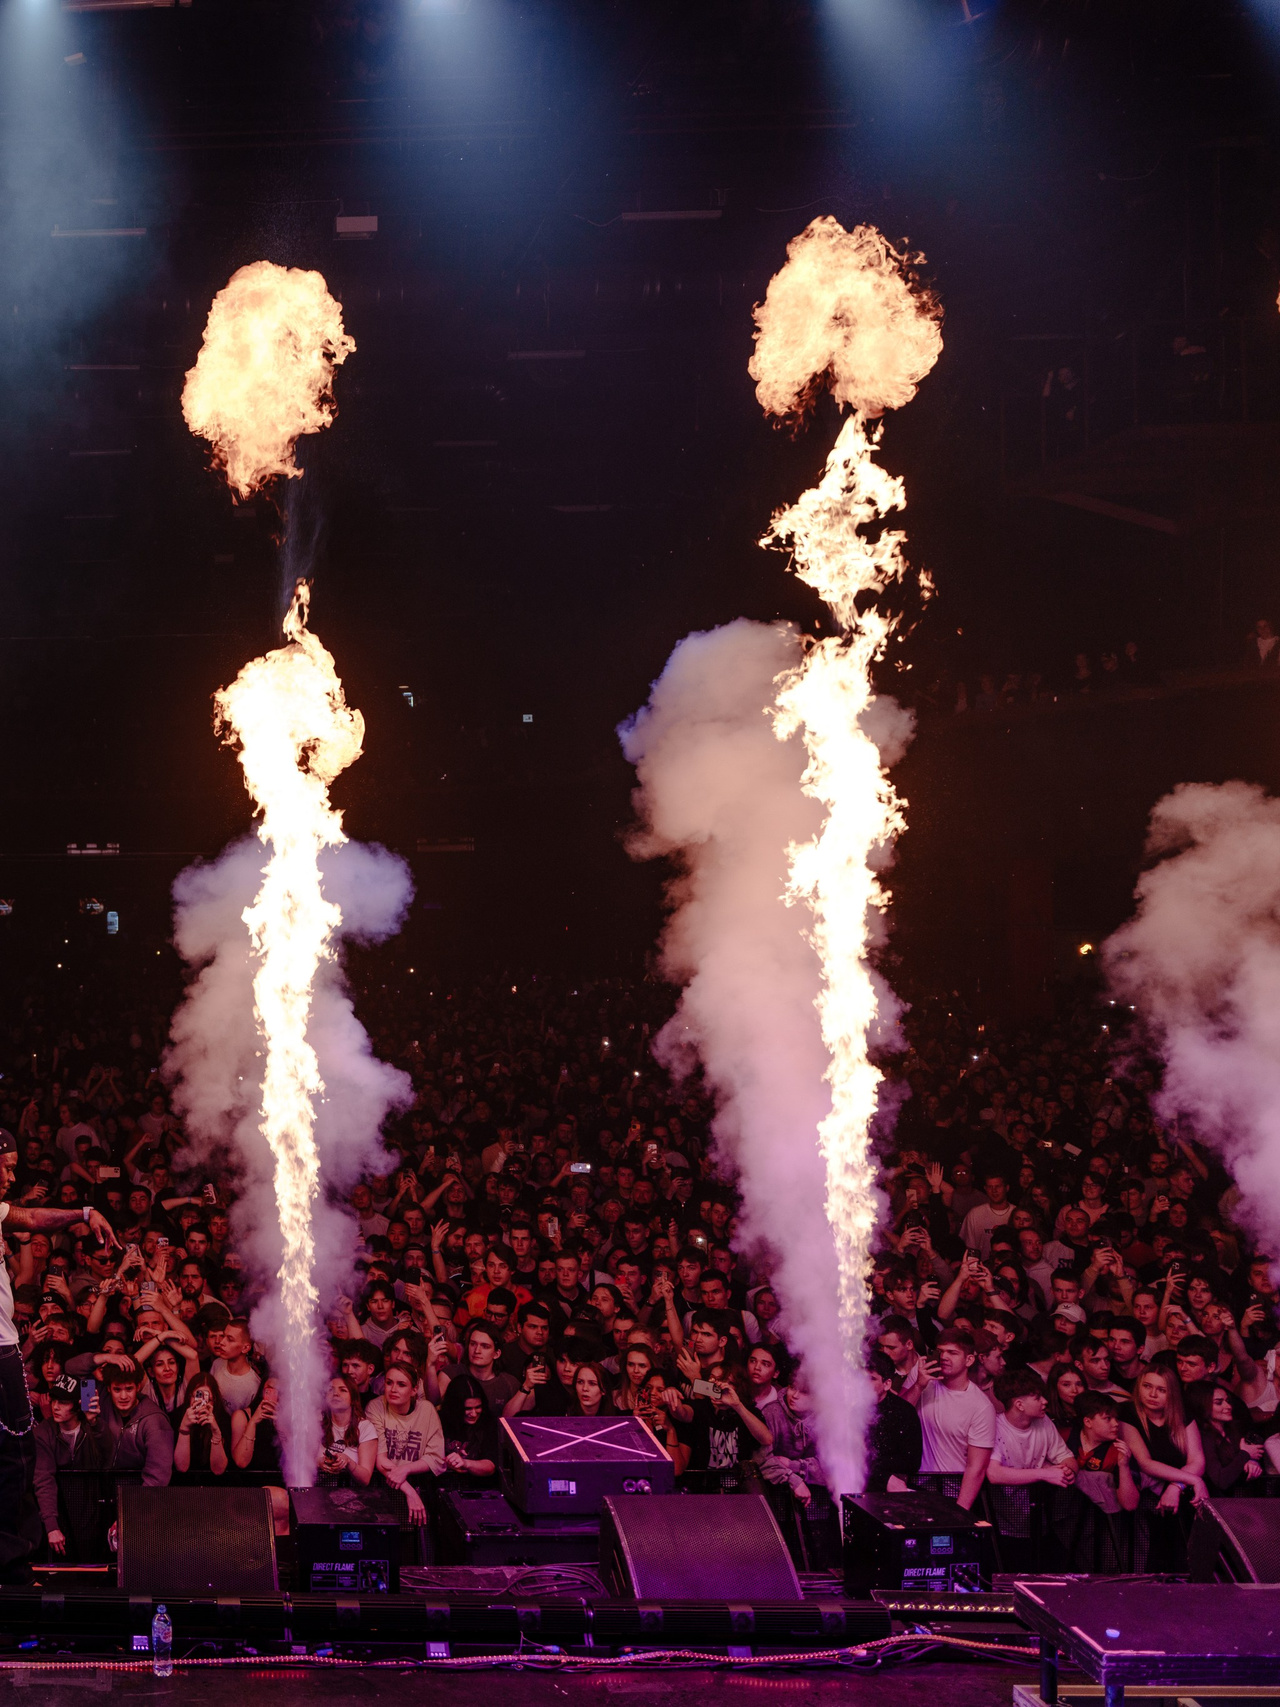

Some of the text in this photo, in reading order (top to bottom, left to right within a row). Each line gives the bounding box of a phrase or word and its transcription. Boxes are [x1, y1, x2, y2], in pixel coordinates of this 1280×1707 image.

[312, 1562, 356, 1571] DIRECT FLAME
[903, 1567, 947, 1577] DIRECT FLAME
